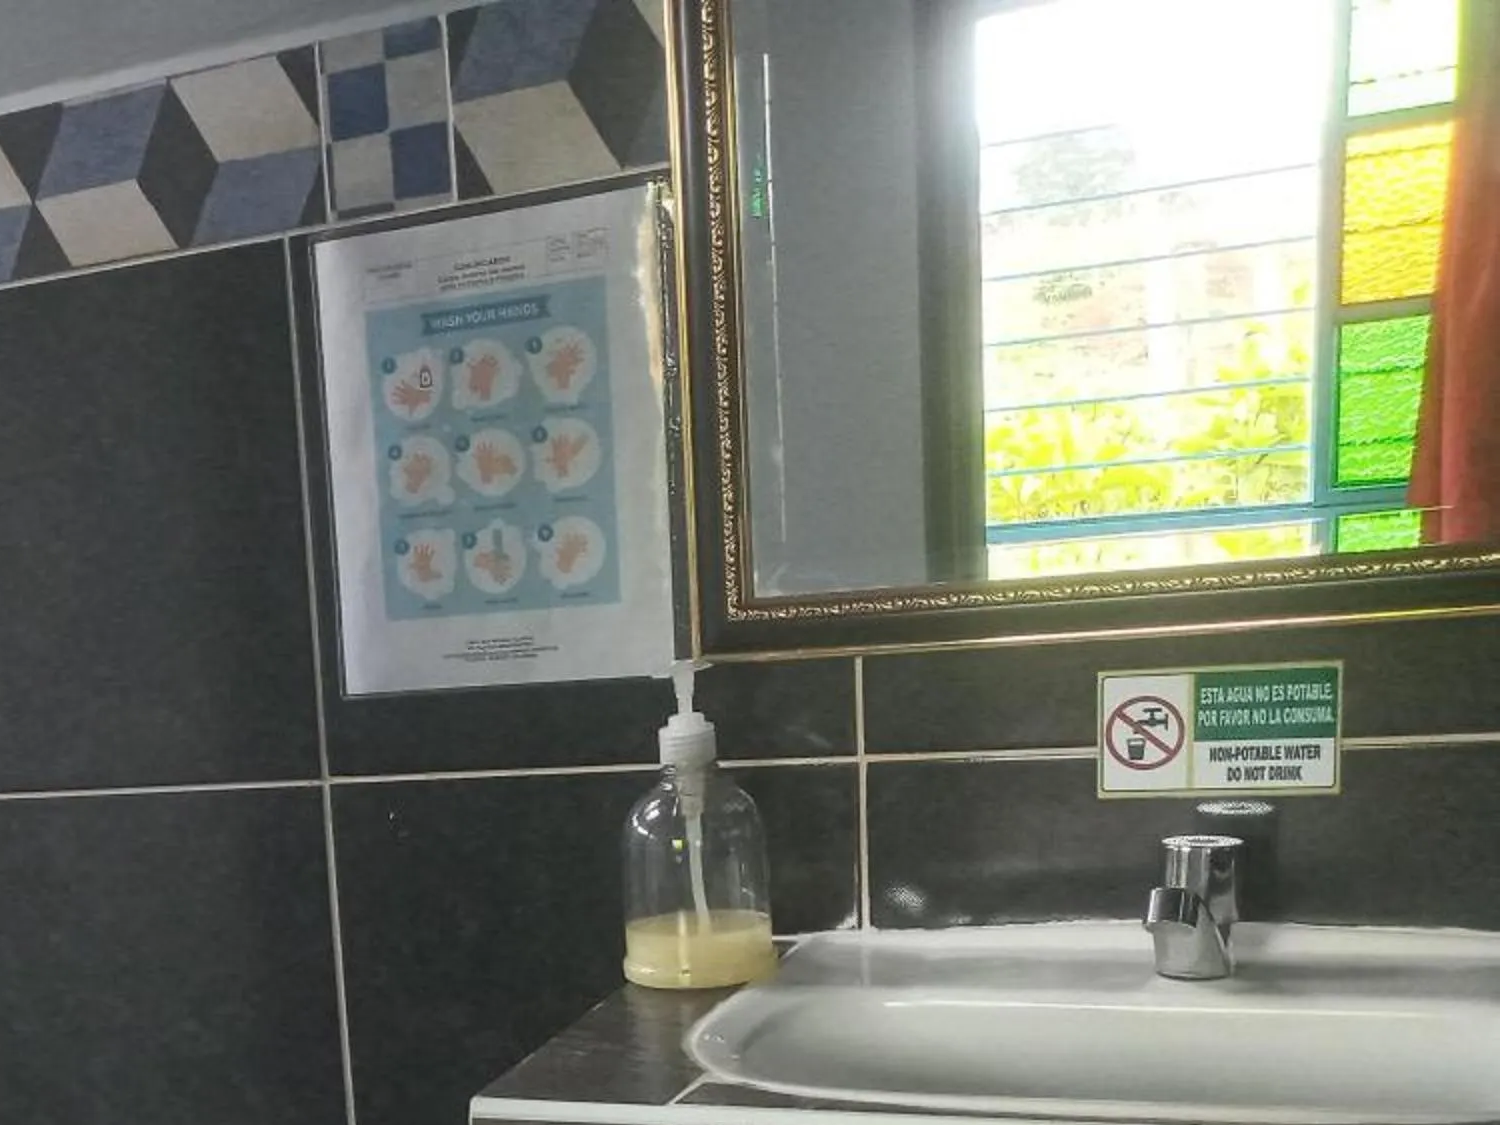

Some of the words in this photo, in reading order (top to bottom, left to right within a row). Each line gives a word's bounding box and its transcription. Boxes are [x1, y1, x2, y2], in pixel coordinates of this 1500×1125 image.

[466, 307, 496, 324] YOUR
[1201, 687, 1224, 705] ESTA
[1227, 685, 1253, 703] AGUA
[1255, 684, 1269, 703] NO
[1271, 683, 1285, 702] ES
[1287, 682, 1333, 701] POTABLE
[1198, 709, 1218, 727] POR
[1220, 708, 1250, 726] FAVOR
[1252, 707, 1267, 725] NO
[1268, 707, 1282, 725] LA
[1209, 745, 1282, 762] NON-POTABLE
[1283, 744, 1321, 761] WATER
[1226, 766, 1241, 782] DO
[1243, 765, 1267, 781] NOT
[1268, 765, 1303, 781] DRINK
